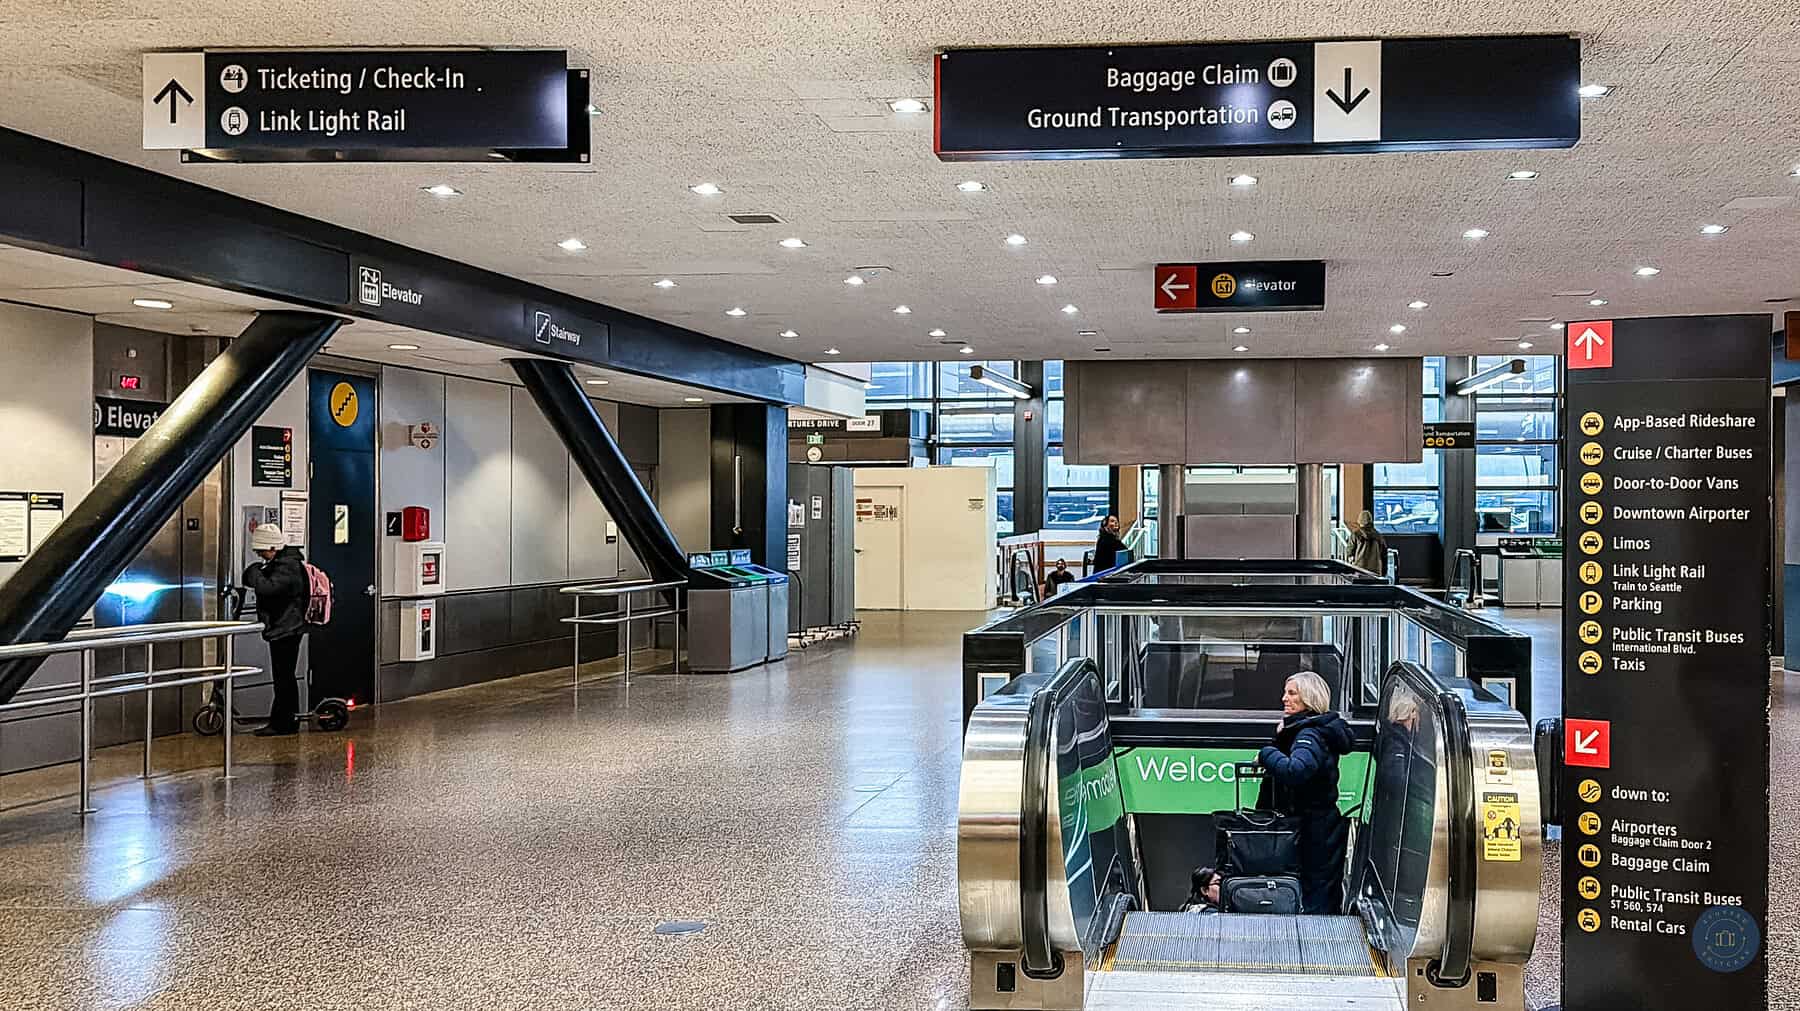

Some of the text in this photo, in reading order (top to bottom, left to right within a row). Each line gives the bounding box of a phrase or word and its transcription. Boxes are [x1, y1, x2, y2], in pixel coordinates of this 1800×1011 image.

[258, 67, 463, 94] Ticketing / Check-In
[1108, 64, 1258, 92] Baggage Claim
[261, 109, 404, 136] Link Light Rail
[1028, 104, 1258, 130] Ground Transportation
[382, 283, 422, 304] Elevator
[551, 325, 580, 345] Stairway
[816, 419, 839, 428] DRIVE
[1614, 414, 1755, 431] App-Based Rideshare
[1614, 446, 1752, 459] Cruise / Charter Buses
[1614, 477, 1738, 489] Door-to-Door Vans
[1614, 507, 1750, 522] Downtown Airporter
[1614, 537, 1650, 549] Limos
[1614, 564, 1704, 580] Link Light Rail
[1613, 582, 1682, 592] Train to Seattle
[1613, 597, 1661, 614] Parking
[1613, 627, 1744, 643] Public Transit Buses
[1613, 642, 1696, 654] International Blvd.
[1613, 657, 1645, 670] Taxis
[1612, 786, 1669, 802] down to:
[1612, 820, 1677, 837] Airporters
[1612, 834, 1711, 849] Baggage Claim Door 2
[1612, 853, 1709, 872] Baggage Claim
[1611, 885, 1741, 905] Public Transit Buses
[1611, 900, 1663, 912] ST 560, 574
[1612, 916, 1685, 934] Rental Cars
